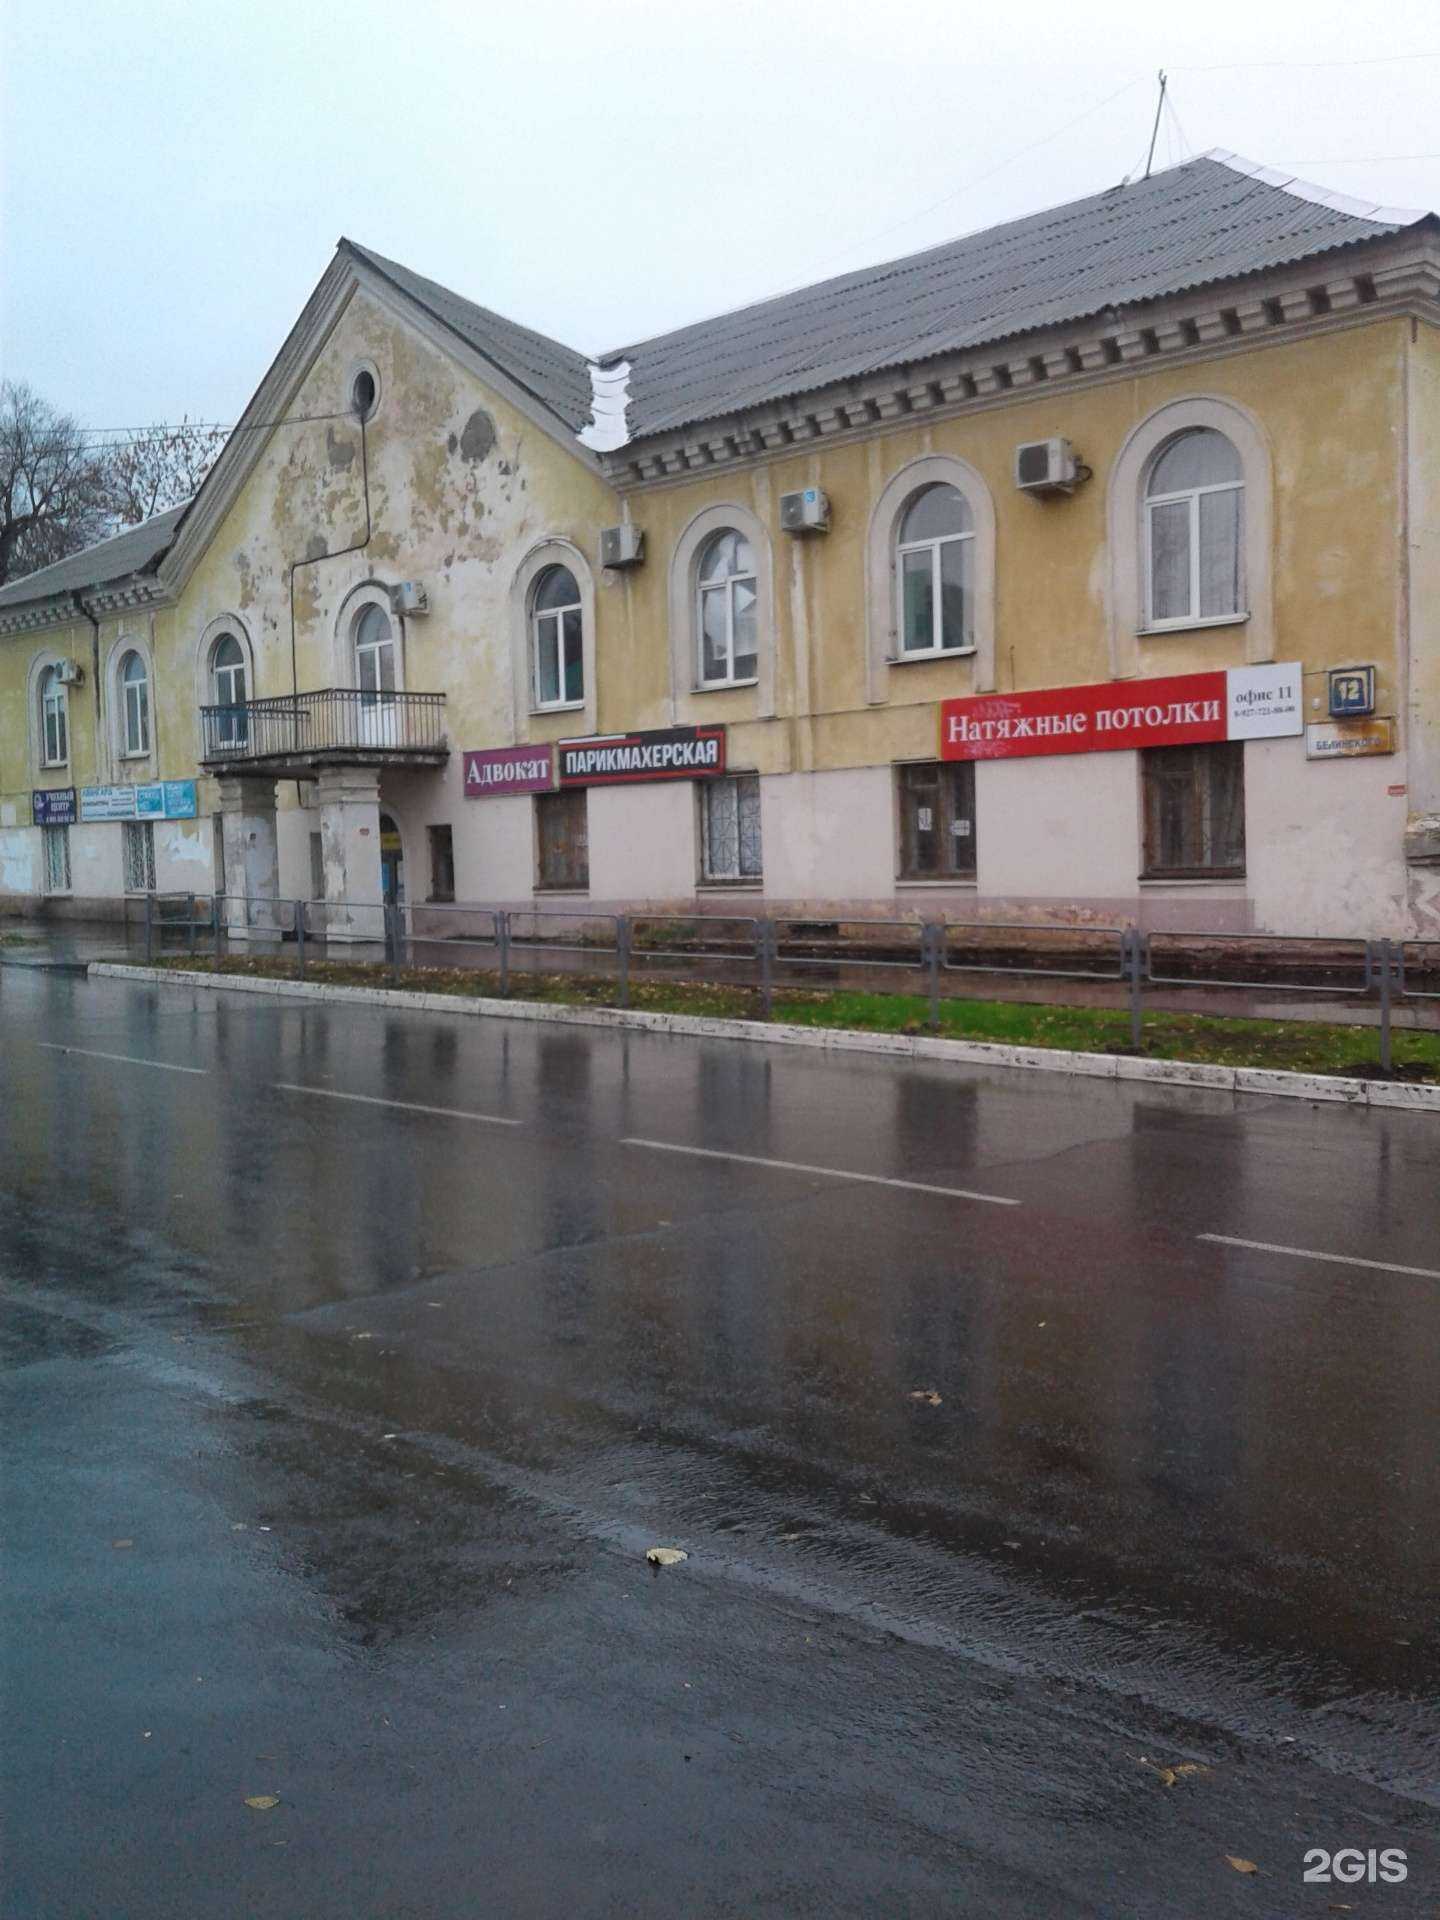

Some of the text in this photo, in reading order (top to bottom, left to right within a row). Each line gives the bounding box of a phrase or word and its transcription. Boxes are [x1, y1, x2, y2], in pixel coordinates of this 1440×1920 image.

[1236, 685, 1293, 706] офис 11
[1338, 680, 1360, 700] 12
[948, 700, 1221, 743] Натяжные потолки
[565, 739, 718, 775] ПАРИКМАХЕРСКАЯ
[466, 759, 550, 787] Адвокат
